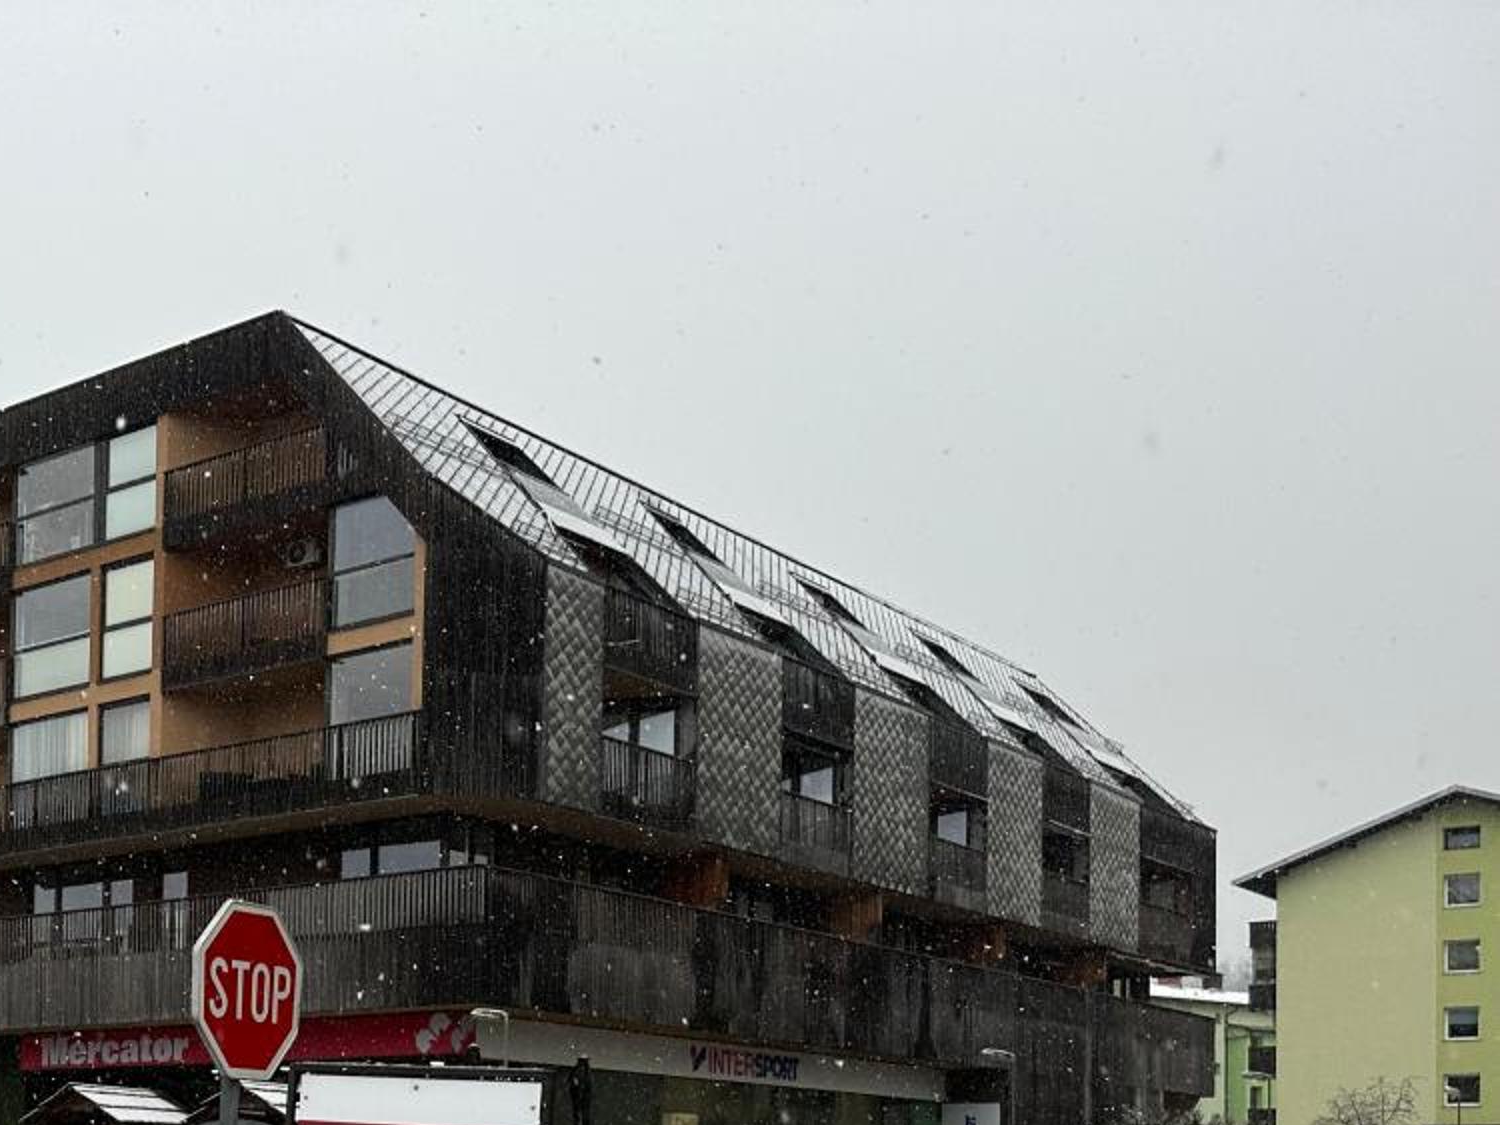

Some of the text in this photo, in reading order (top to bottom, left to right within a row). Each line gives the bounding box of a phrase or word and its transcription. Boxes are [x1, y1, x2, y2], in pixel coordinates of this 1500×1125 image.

[209, 957, 292, 1025] STOP
[41, 1034, 189, 1067] Mercator
[708, 1046, 799, 1081] INTERSPORT
